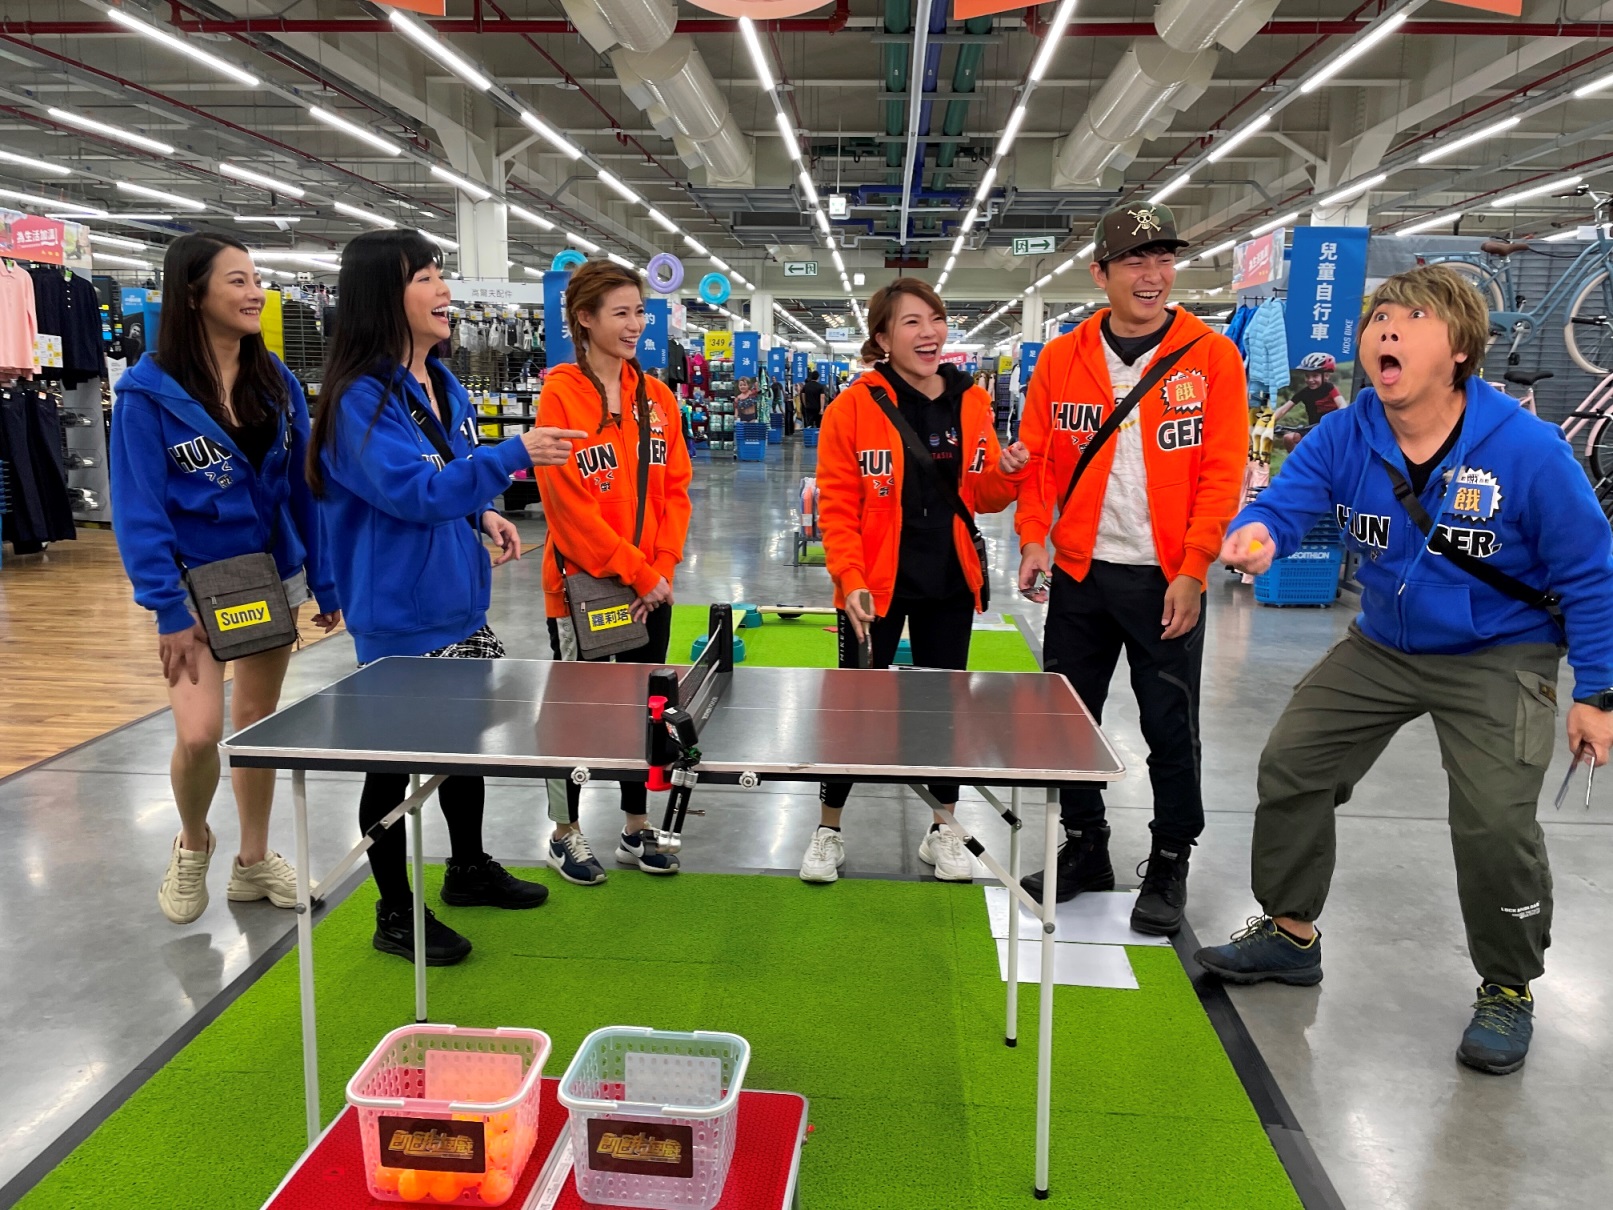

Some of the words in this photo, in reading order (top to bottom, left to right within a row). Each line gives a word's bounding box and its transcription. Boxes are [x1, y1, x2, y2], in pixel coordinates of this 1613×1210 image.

[1310, 241, 1338, 341] 兒童自行車
[711, 338, 725, 347] 349
[1342, 336, 1351, 355] KIDS
[1175, 381, 1196, 402] 餓
[1052, 401, 1104, 433] HUN
[1453, 486, 1481, 512] 餓
[1336, 503, 1391, 549] HUN
[220, 606, 265, 626] Sunny
